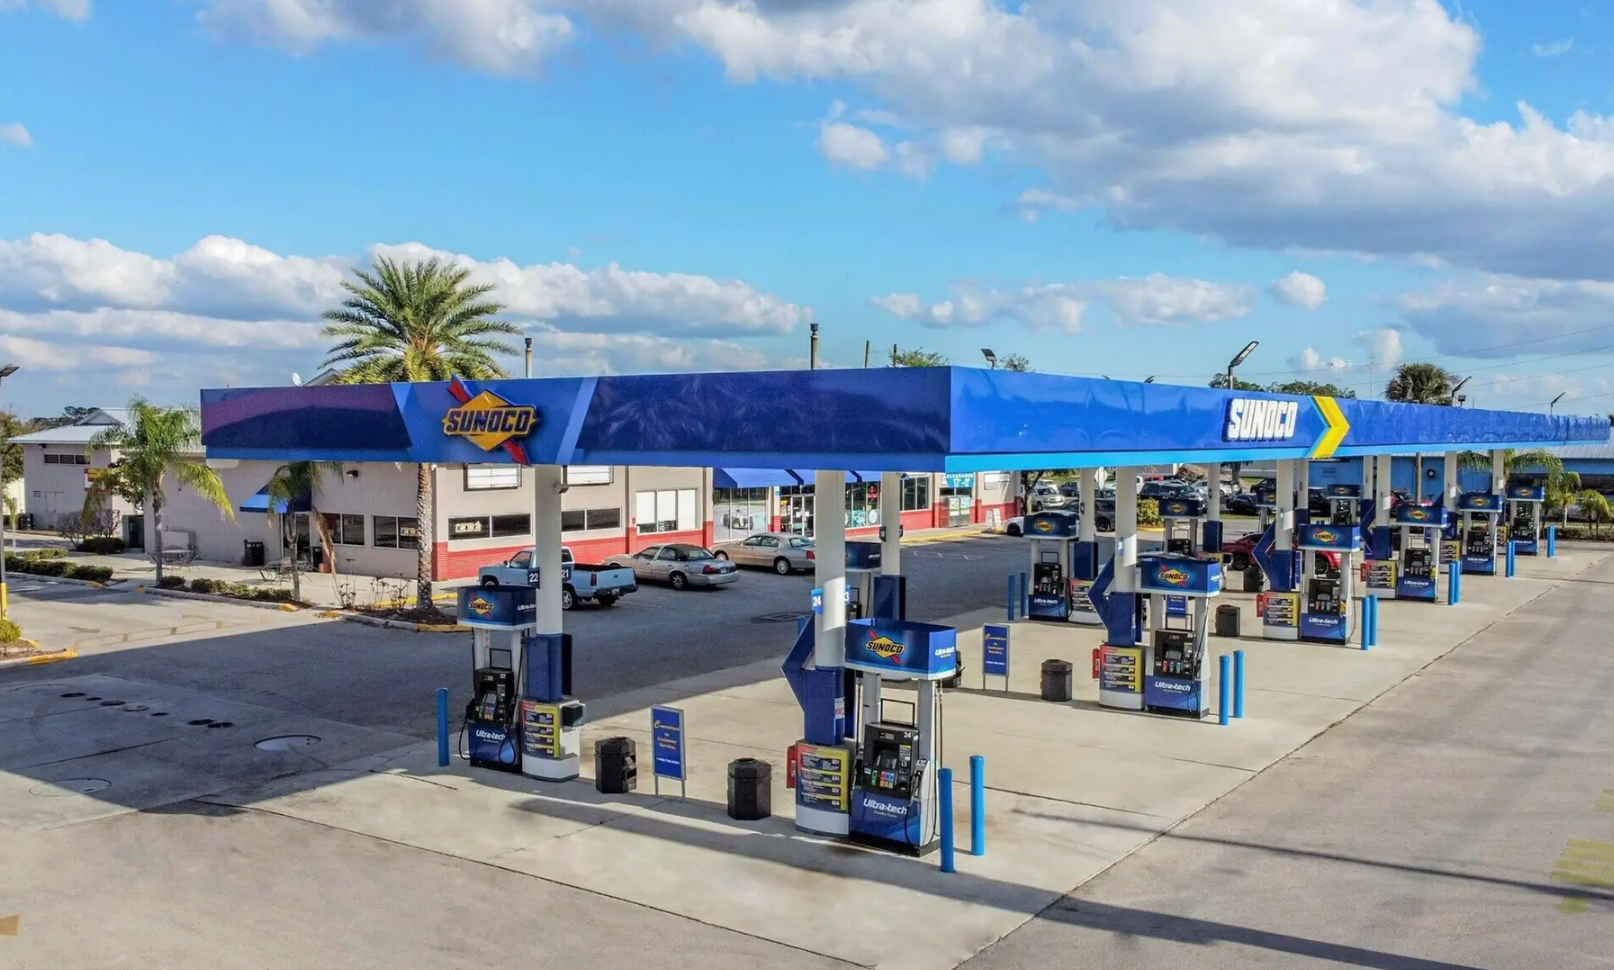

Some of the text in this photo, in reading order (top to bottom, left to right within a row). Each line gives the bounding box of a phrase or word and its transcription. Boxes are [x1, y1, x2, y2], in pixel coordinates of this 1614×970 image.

[446, 410, 532, 433] SUNOCO
[1227, 398, 1298, 439] SUNOCO
[529, 573, 538, 583] 22
[1159, 572, 1189, 581] SUNOCO
[812, 595, 822, 607] 24
[866, 641, 904, 654] SUNOCO
[903, 731, 912, 739] 24
